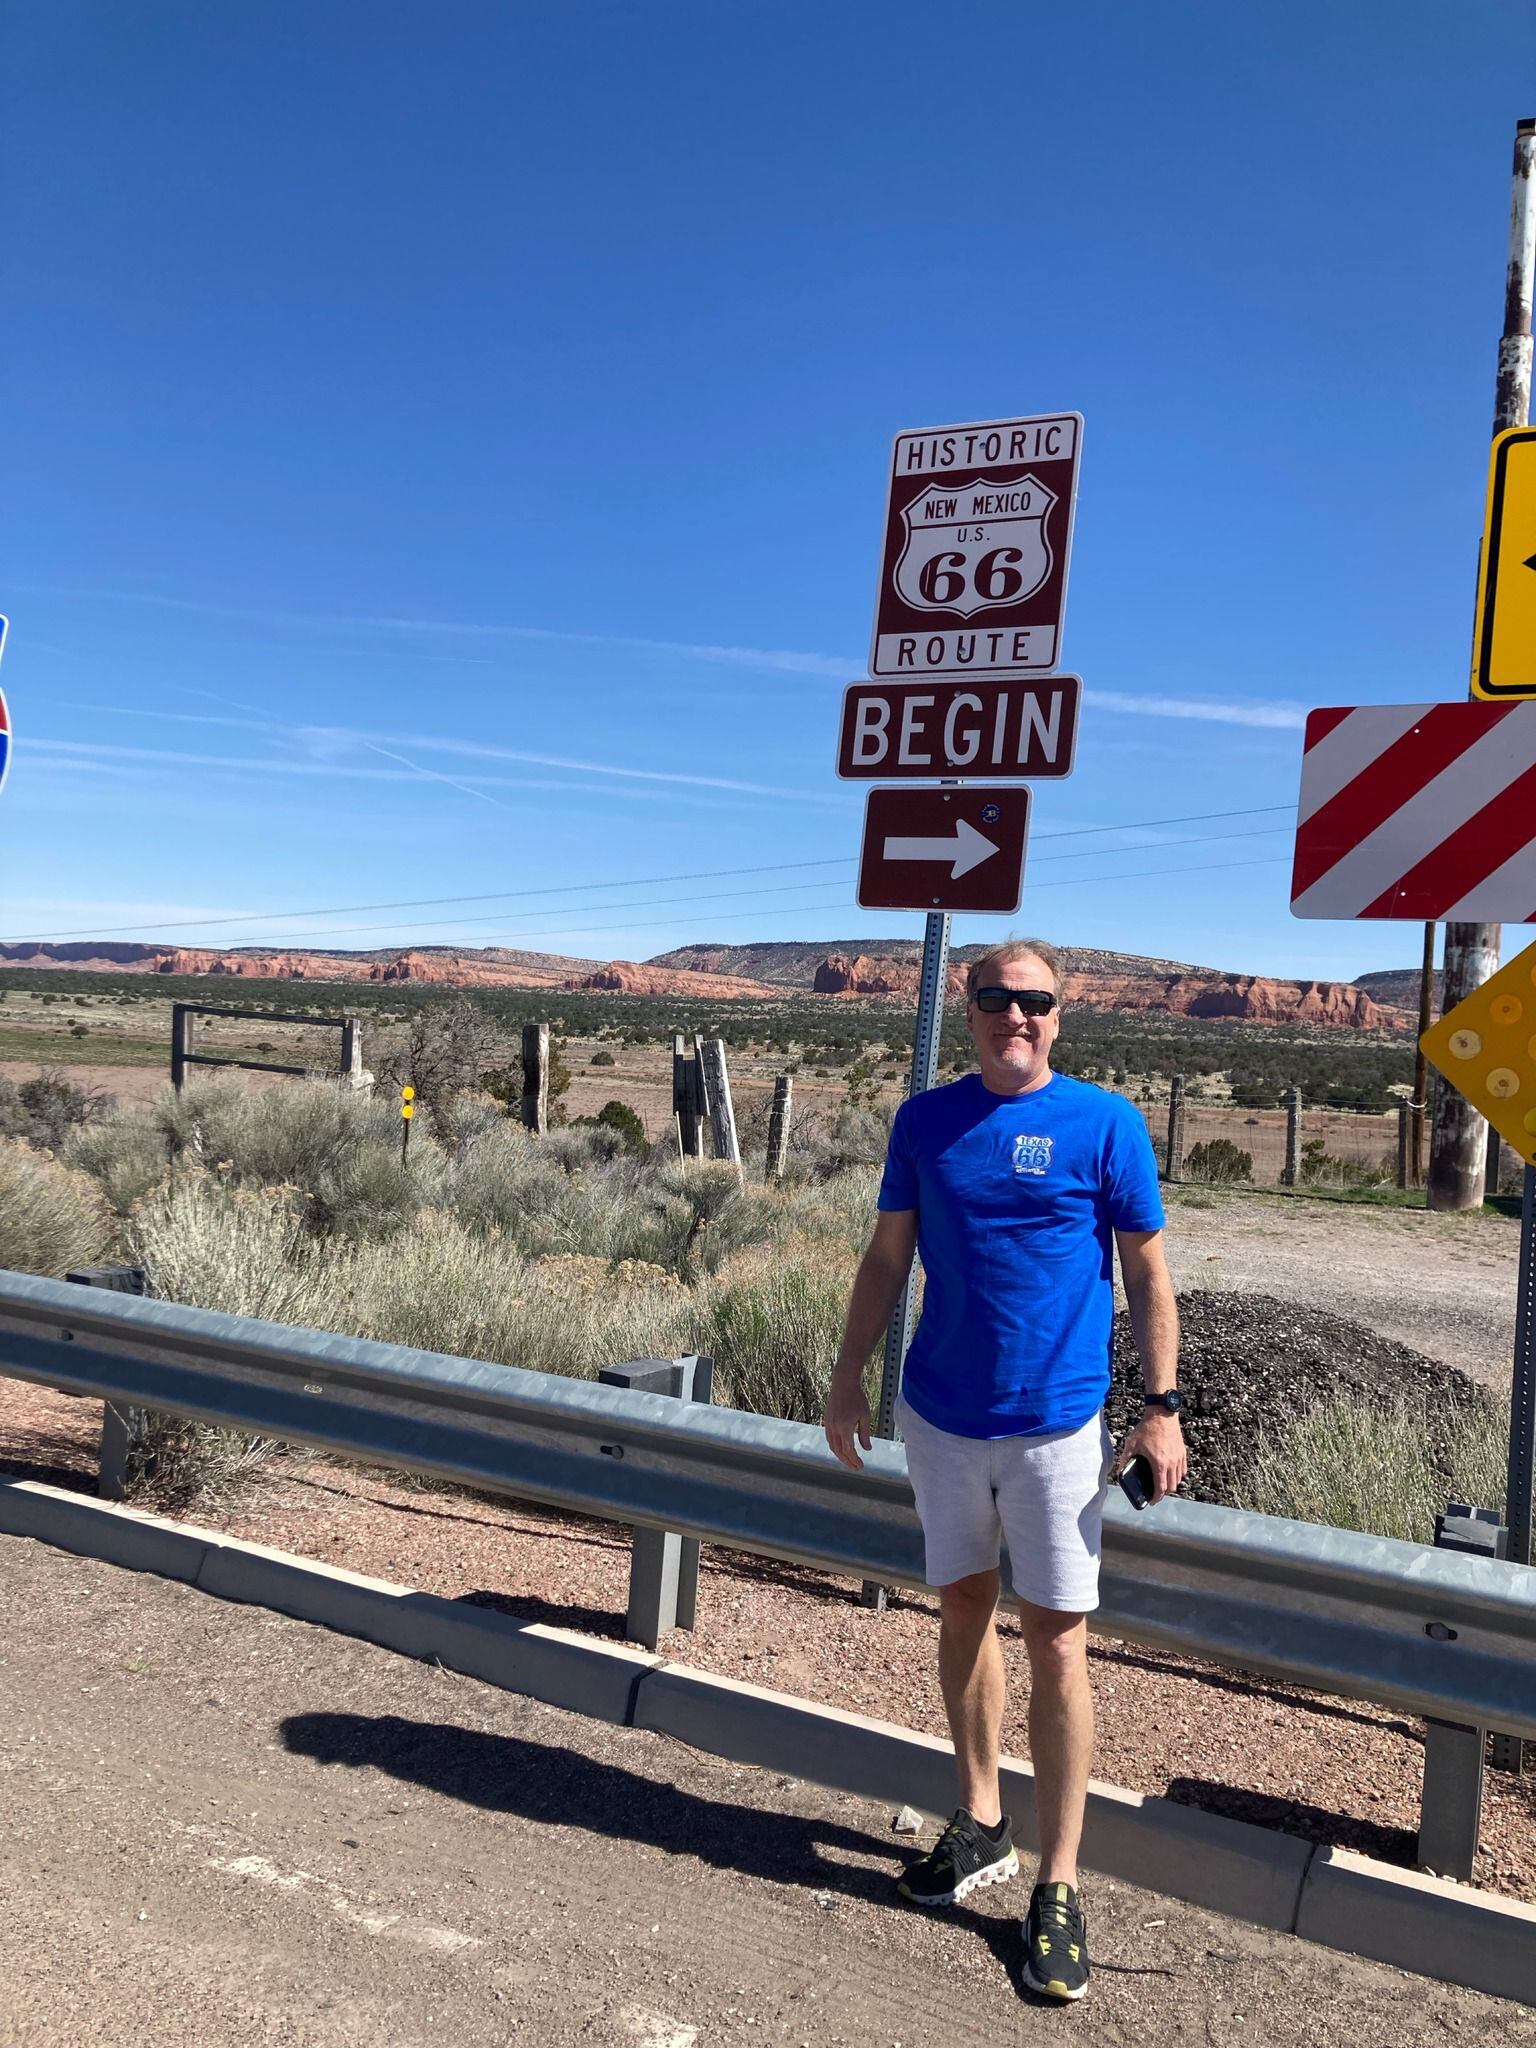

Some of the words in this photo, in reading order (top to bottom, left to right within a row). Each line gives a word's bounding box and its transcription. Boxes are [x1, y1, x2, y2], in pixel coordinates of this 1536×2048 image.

[907, 426, 1062, 470] HISTORIC
[924, 499, 958, 520] NEW
[972, 491, 1031, 516] MEXICO
[957, 526, 990, 543] U.S.
[919, 547, 1023, 603] 66
[897, 632, 1031, 666] ROUTE
[851, 690, 1063, 765] BEGIN
[1018, 1147, 1047, 1166] 66
[1021, 1136, 1049, 1146] TEXAS
